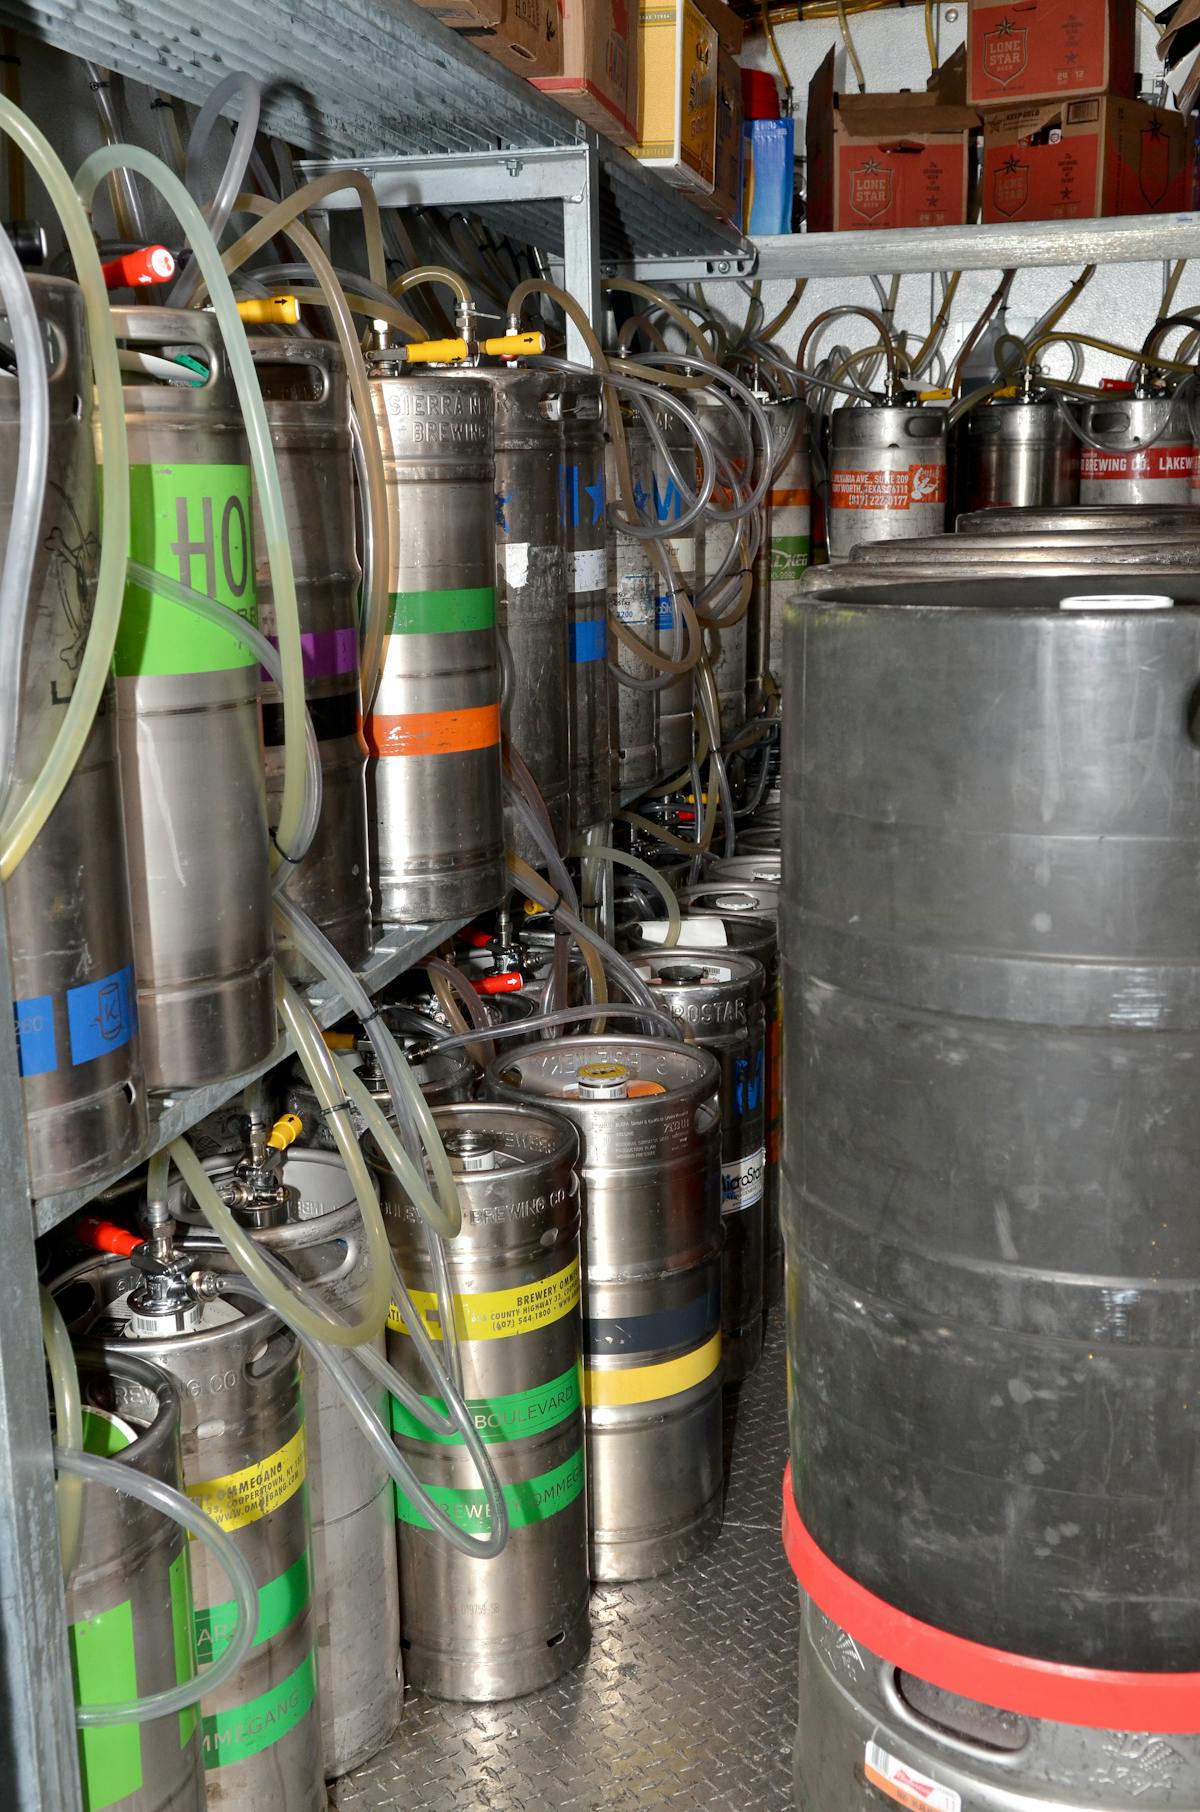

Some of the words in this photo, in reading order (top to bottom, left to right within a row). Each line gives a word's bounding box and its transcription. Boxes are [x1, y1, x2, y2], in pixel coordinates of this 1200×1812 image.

[989, 40, 1021, 54] LONE
[989, 52, 1021, 66] STAR
[856, 179, 886, 190] LONE
[856, 191, 886, 202] STAR
[389, 394, 463, 416] SIERRA
[897, 474, 909, 483] 209
[470, 1195, 545, 1225] BREWING
[516, 1284, 557, 1308] BREWERY
[490, 1308, 521, 1321] COUNTY
[522, 1298, 552, 1315] HIGHWAY
[517, 1307, 552, 1325] 544-1800
[209, 1369, 237, 1393] CO
[474, 1384, 576, 1431] BOULEVARD
